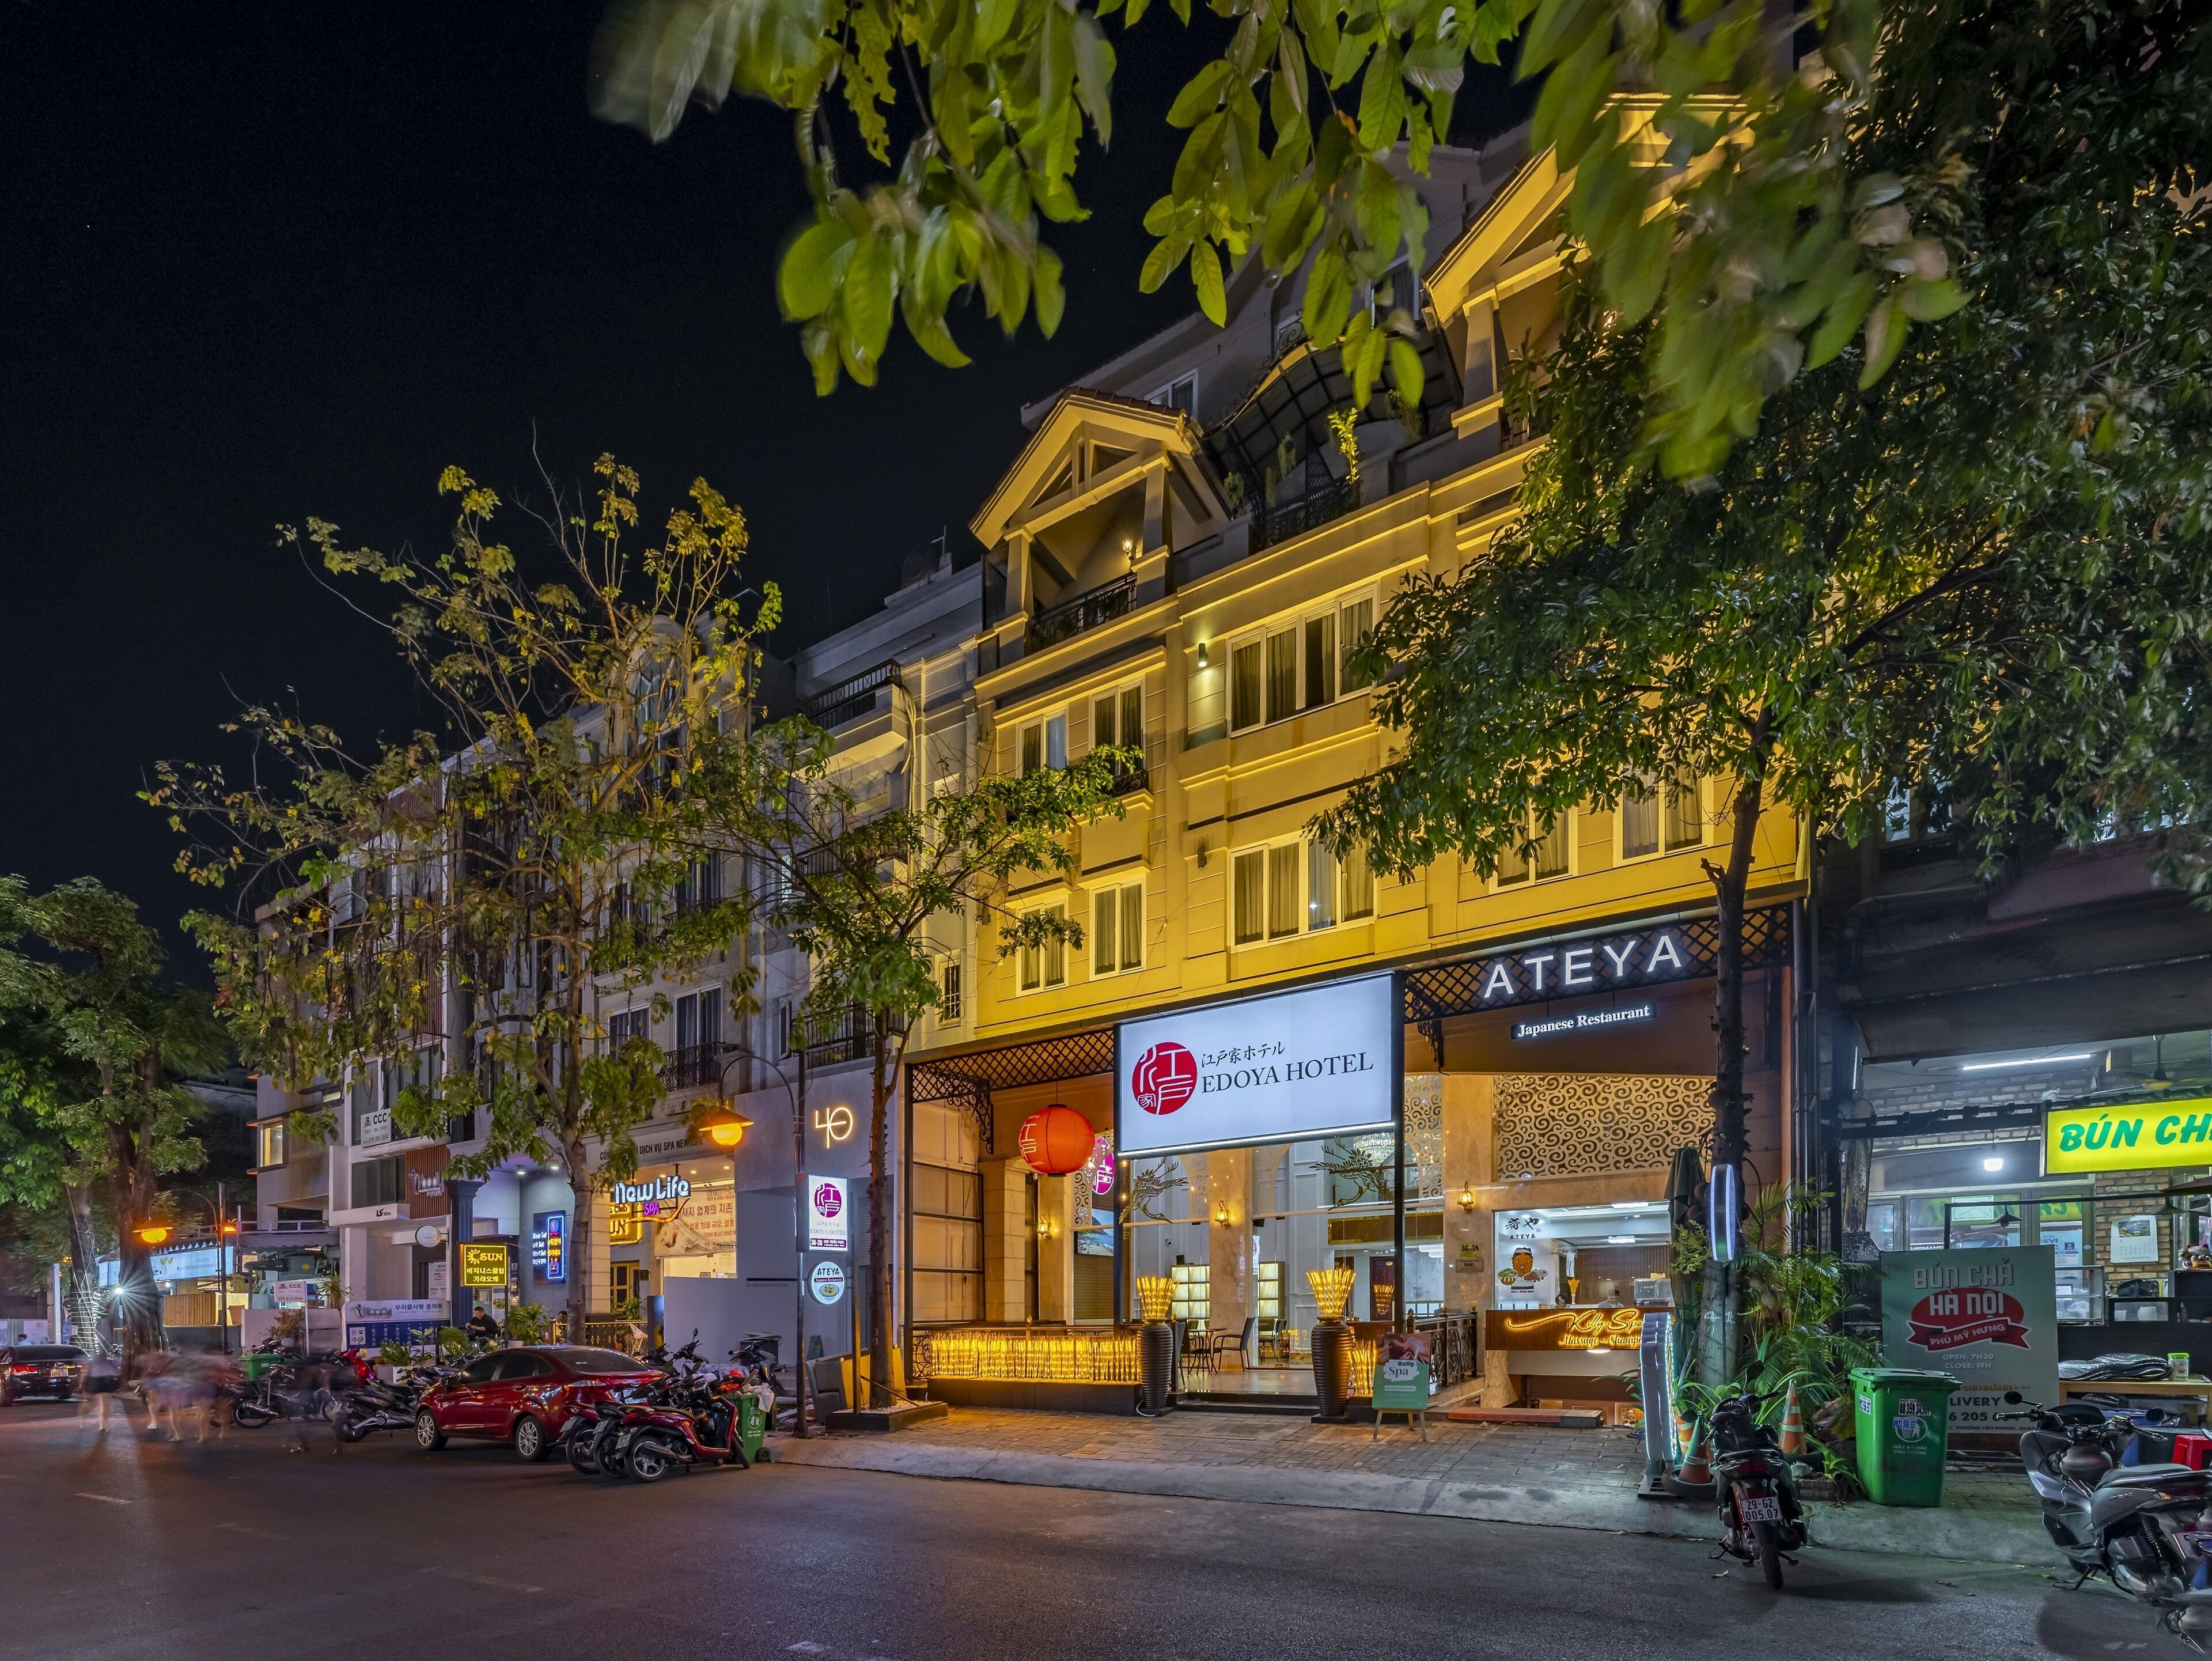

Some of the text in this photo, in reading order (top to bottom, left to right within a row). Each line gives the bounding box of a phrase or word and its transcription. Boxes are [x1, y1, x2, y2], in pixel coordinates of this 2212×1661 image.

[1484, 934, 1682, 998] ATEYA
[1518, 1005, 1649, 1037] Japanese Restaurant
[1202, 1041, 1285, 1068] 江戸家ホテル
[1202, 1052, 1374, 1094] EDOYA HOTEL
[373, 1113, 387, 1124] CCC
[2060, 1113, 2212, 1152] BÚN CH
[639, 1145, 653, 1156] DỊCH
[654, 1143, 662, 1154] VỤ
[664, 1140, 675, 1151] SPA
[657, 1176, 690, 1199] Life
[615, 1204, 627, 1213] Club
[644, 1203, 660, 1216] SPA
[697, 1205, 715, 1216] 업계의
[719, 1203, 732, 1213] 지존
[1461, 1244, 1479, 1253] 36-38
[817, 1267, 839, 1276] ATEYA
[1914, 1258, 2014, 1289] BÚN CHẢ
[1930, 1289, 2004, 1318] HÀ NỘI
[1608, 1309, 1642, 1334] Spa
[1930, 1335, 1950, 1345] PHÚ
[1954, 1330, 1969, 1341] MỸ
[1389, 1367, 1408, 1378] Spa
[1950, 1397, 2001, 1406] LIVERY
[1961, 1412, 1987, 1421] 205
[1746, 1499, 1774, 1509] 29-G2
[1745, 1509, 1778, 1520] 005.07
